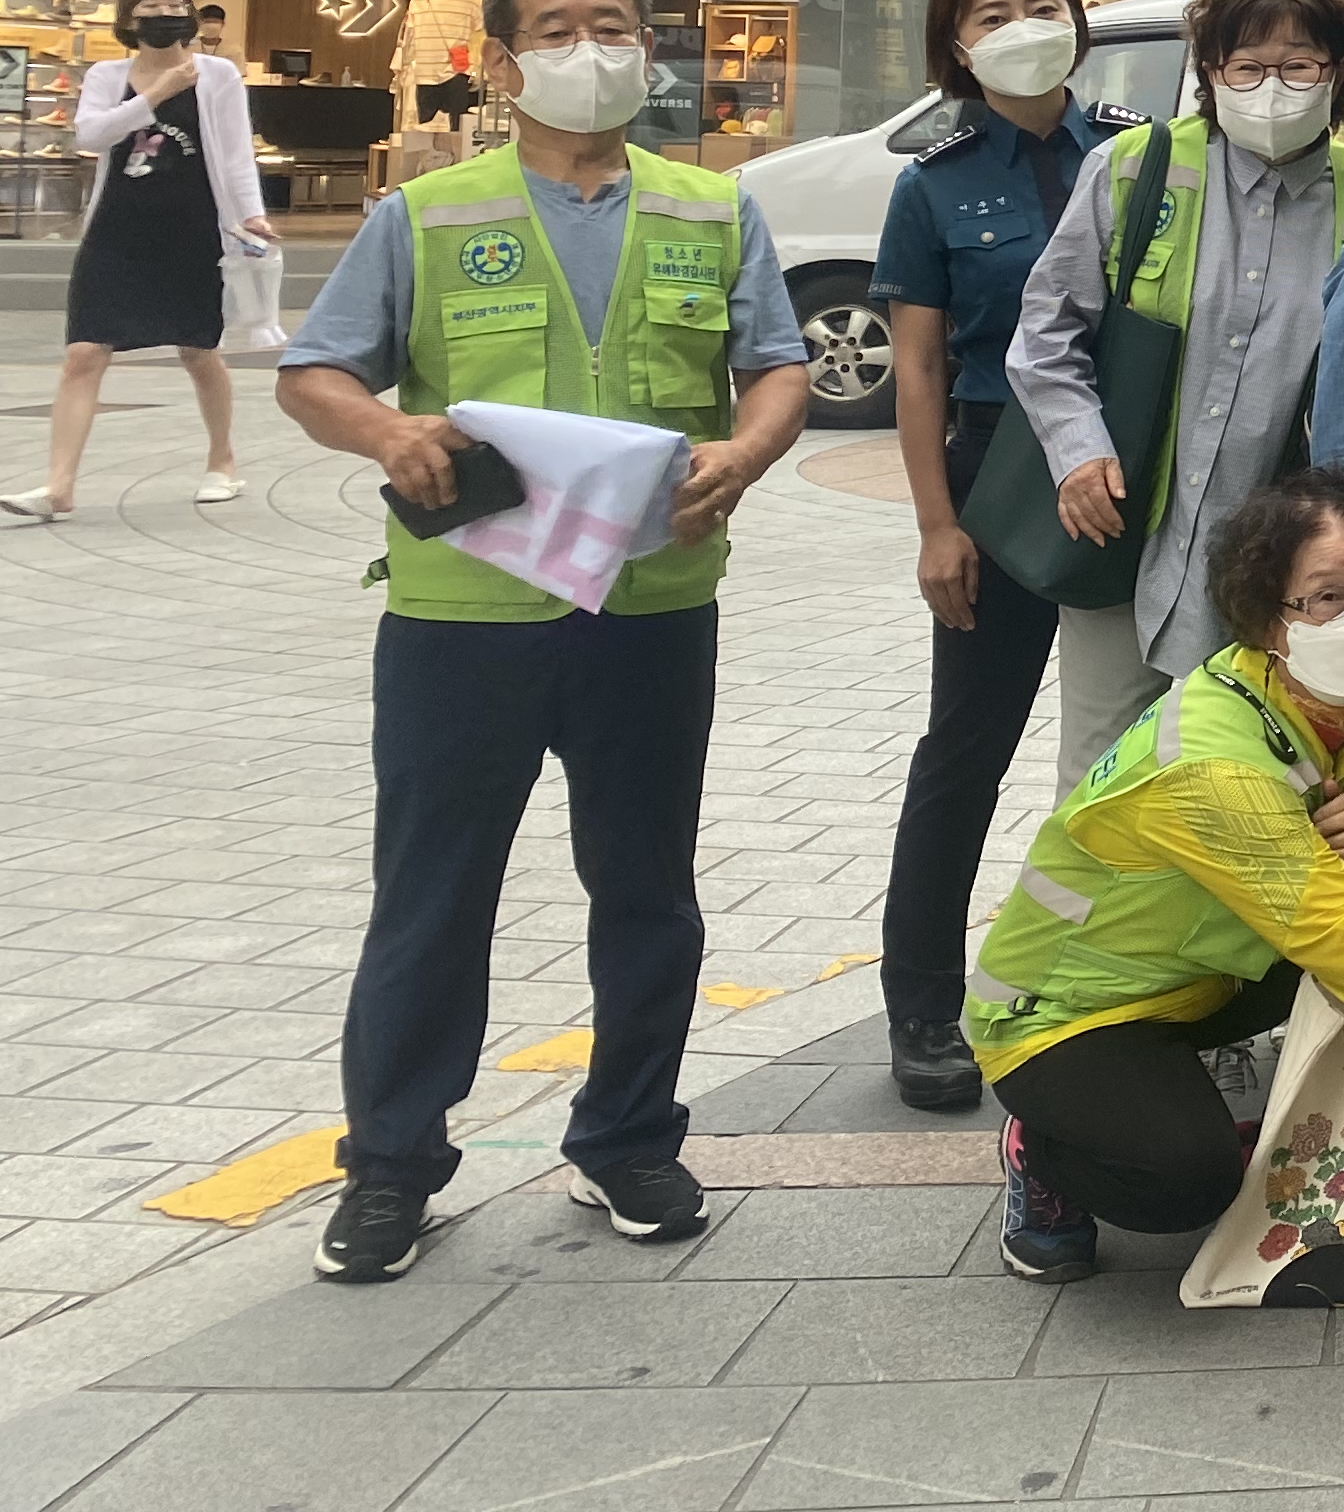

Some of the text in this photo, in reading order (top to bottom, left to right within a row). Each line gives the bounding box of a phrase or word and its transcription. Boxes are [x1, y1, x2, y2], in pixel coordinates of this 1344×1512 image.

[643, 98, 692, 108] NVERSE
[664, 246, 702, 261] 청소년
[452, 302, 537, 322] 부산광역시지부
